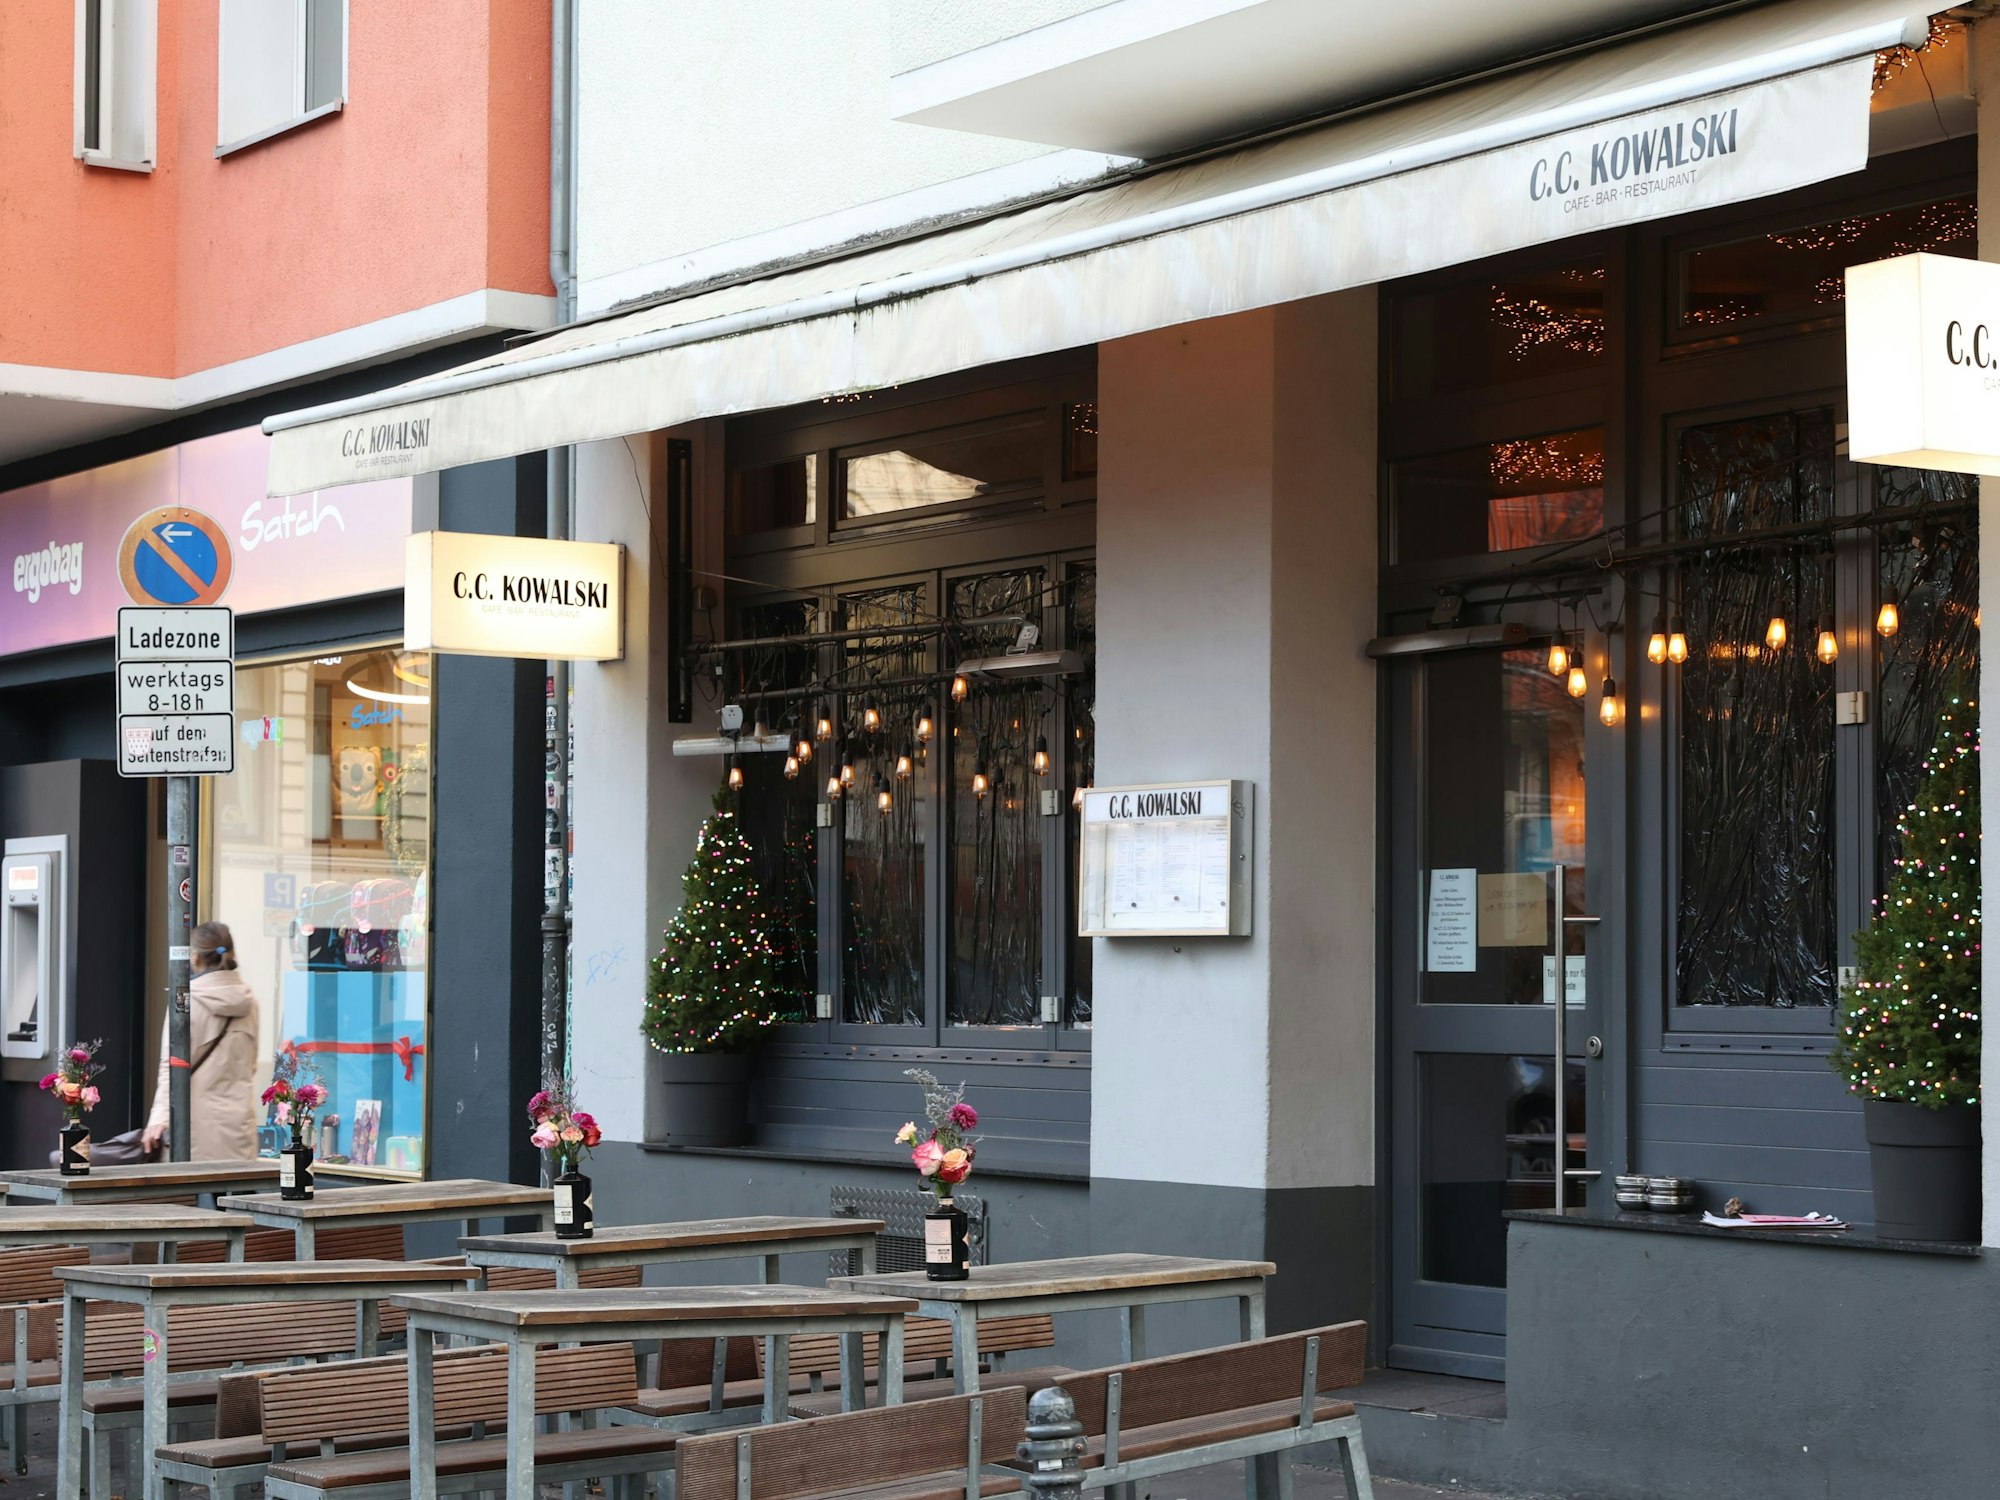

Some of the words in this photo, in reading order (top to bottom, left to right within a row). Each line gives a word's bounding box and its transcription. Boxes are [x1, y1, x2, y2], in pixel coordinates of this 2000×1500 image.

[1529, 151, 1579, 202] C.C.
[1590, 108, 1738, 186] KOWALSKI
[1596, 189, 1617, 206] BAR
[1624, 169, 1697, 198] RESTAURANT
[1946, 320, 1998, 370] C.C.
[342, 428, 365, 457] C.C.
[369, 418, 430, 454] KOWALSKI
[13, 541, 84, 604] ergobag
[453, 571, 494, 600] C.C.
[503, 575, 608, 609] KOWALSKI
[528, 607, 581, 619] RESTAURANT
[129, 626, 220, 649] Ladezone
[127, 670, 224, 692] werktags
[1109, 795, 1133, 819] C.C.
[1137, 791, 1202, 817] KOWALSKI
